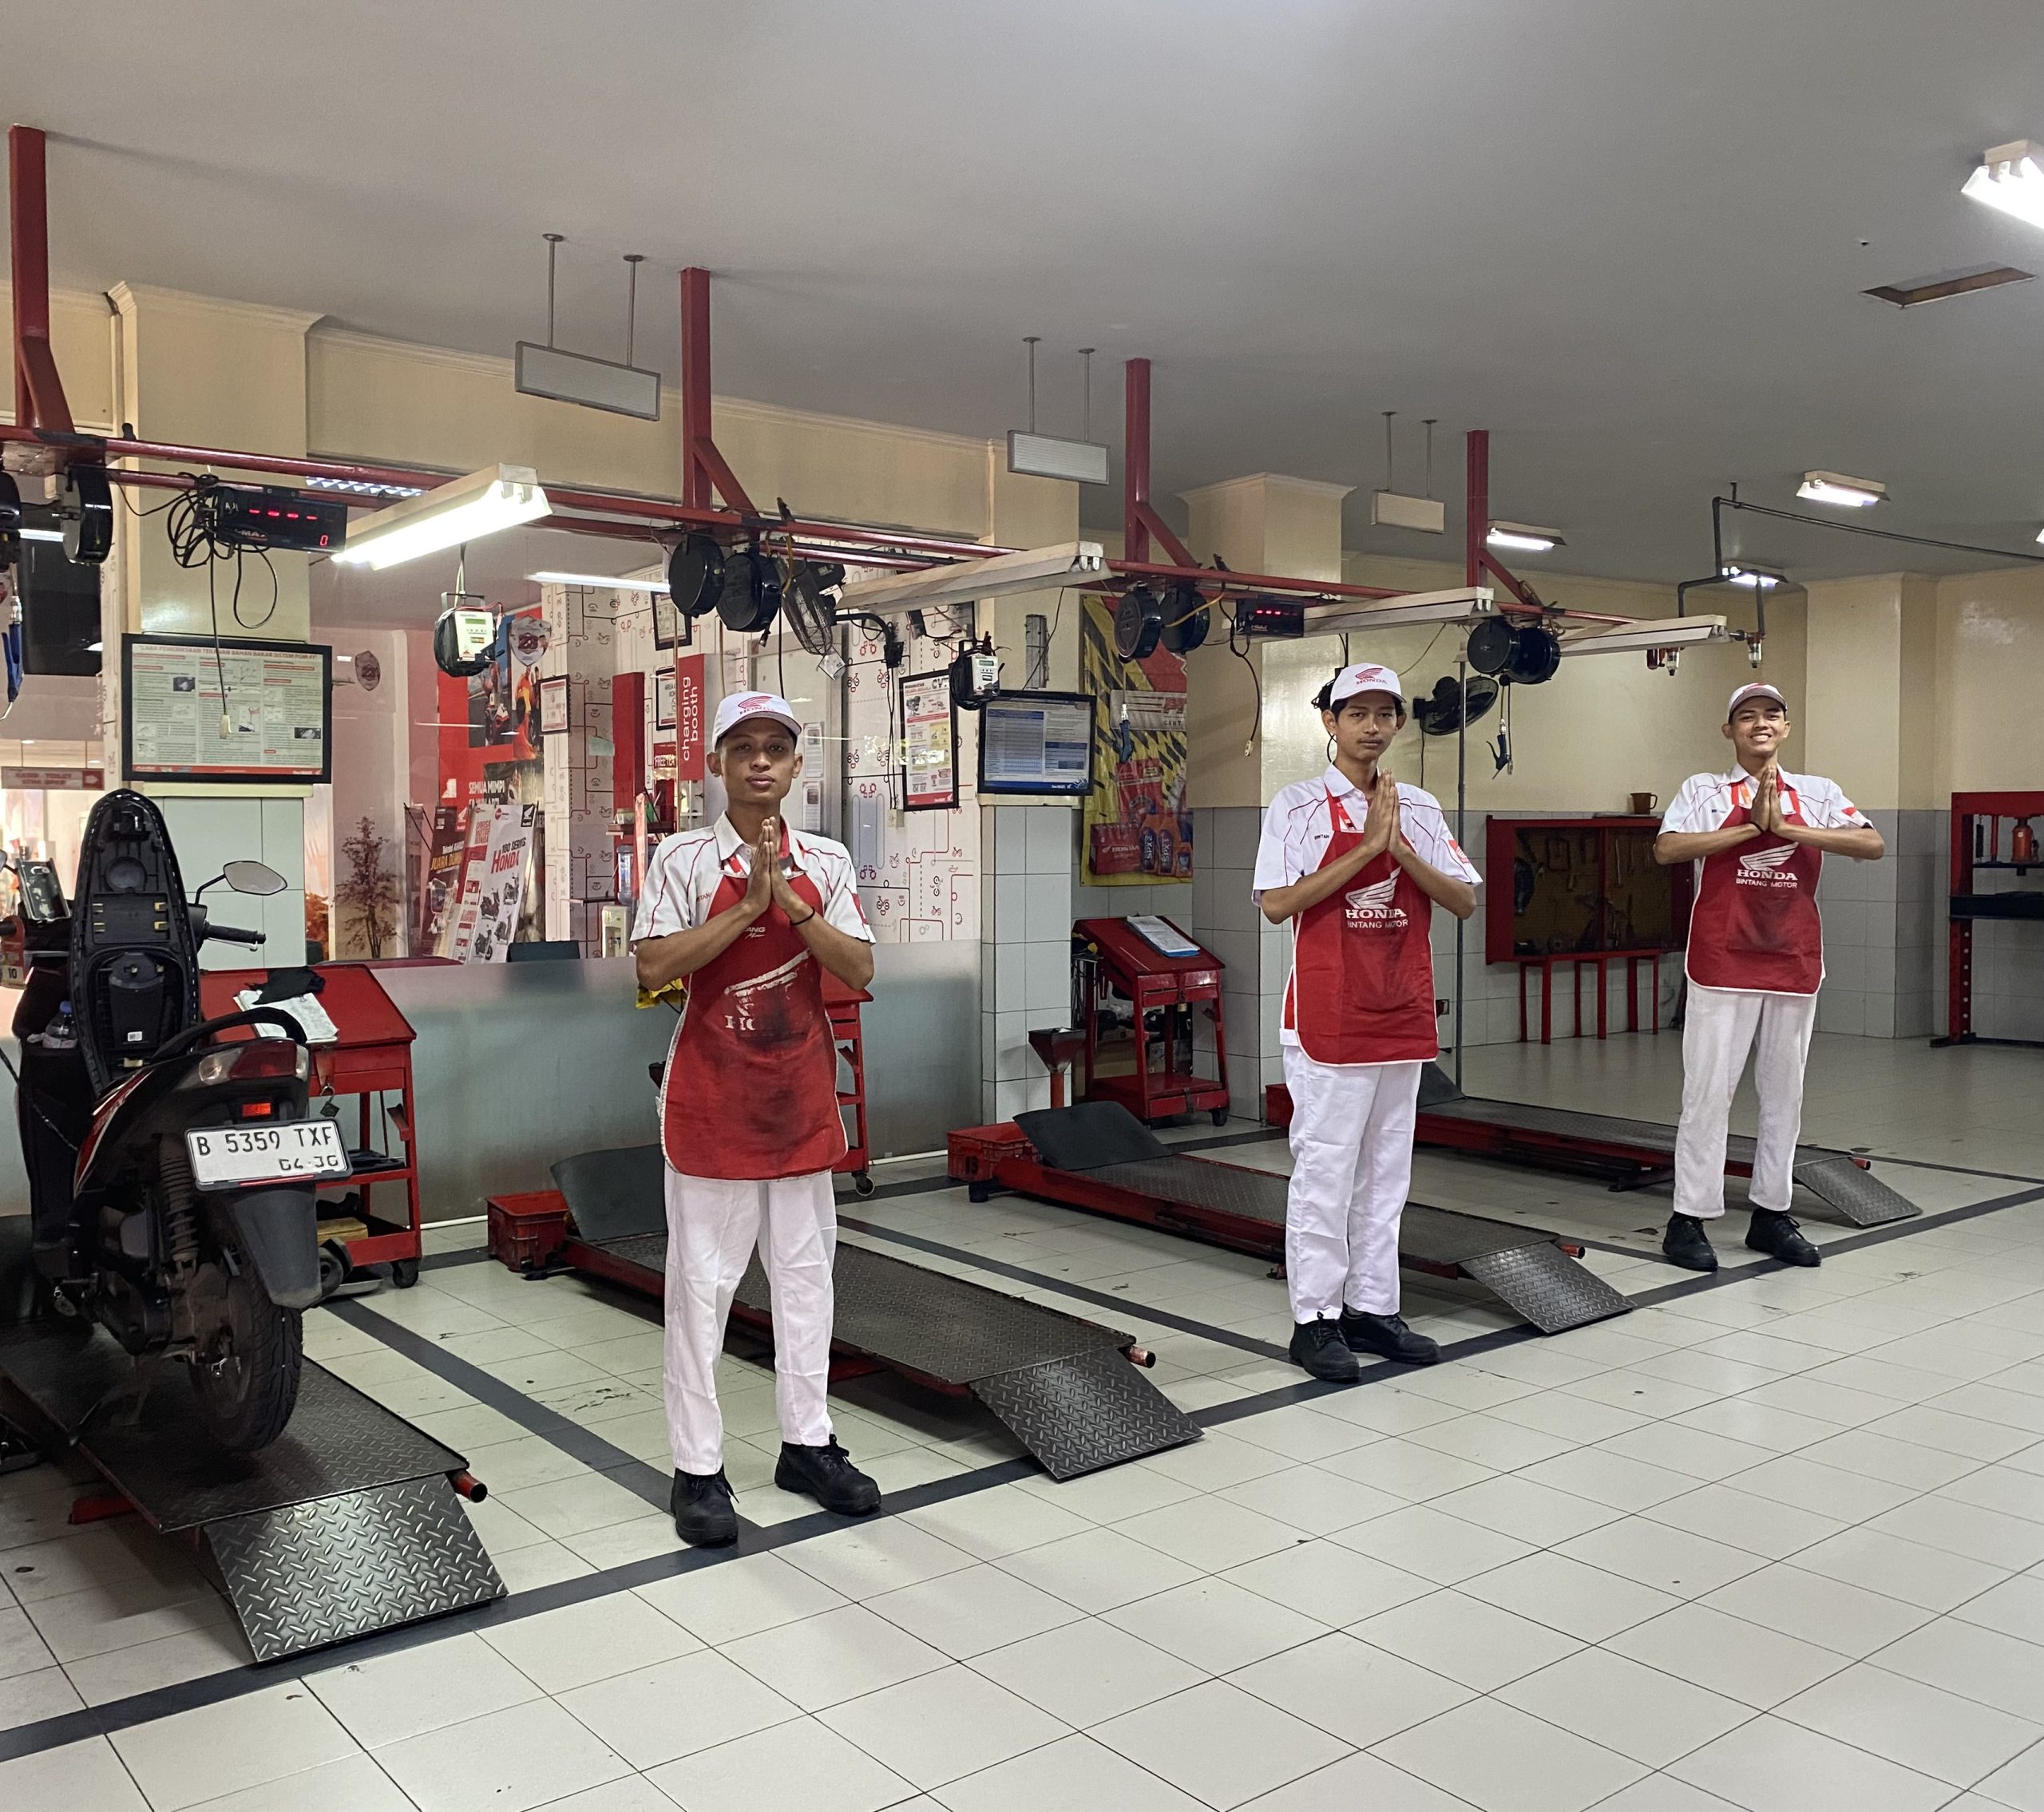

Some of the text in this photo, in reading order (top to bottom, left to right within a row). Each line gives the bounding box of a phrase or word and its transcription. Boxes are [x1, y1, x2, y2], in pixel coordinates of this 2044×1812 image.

[681, 676, 692, 762] charging
[690, 686, 699, 742] booth
[1736, 877, 1768, 888] BINTANG
[1737, 868, 1799, 881] HONDA
[8, 967, 18, 979] 10
[196, 1126, 332, 1157] B 5359 TXF
